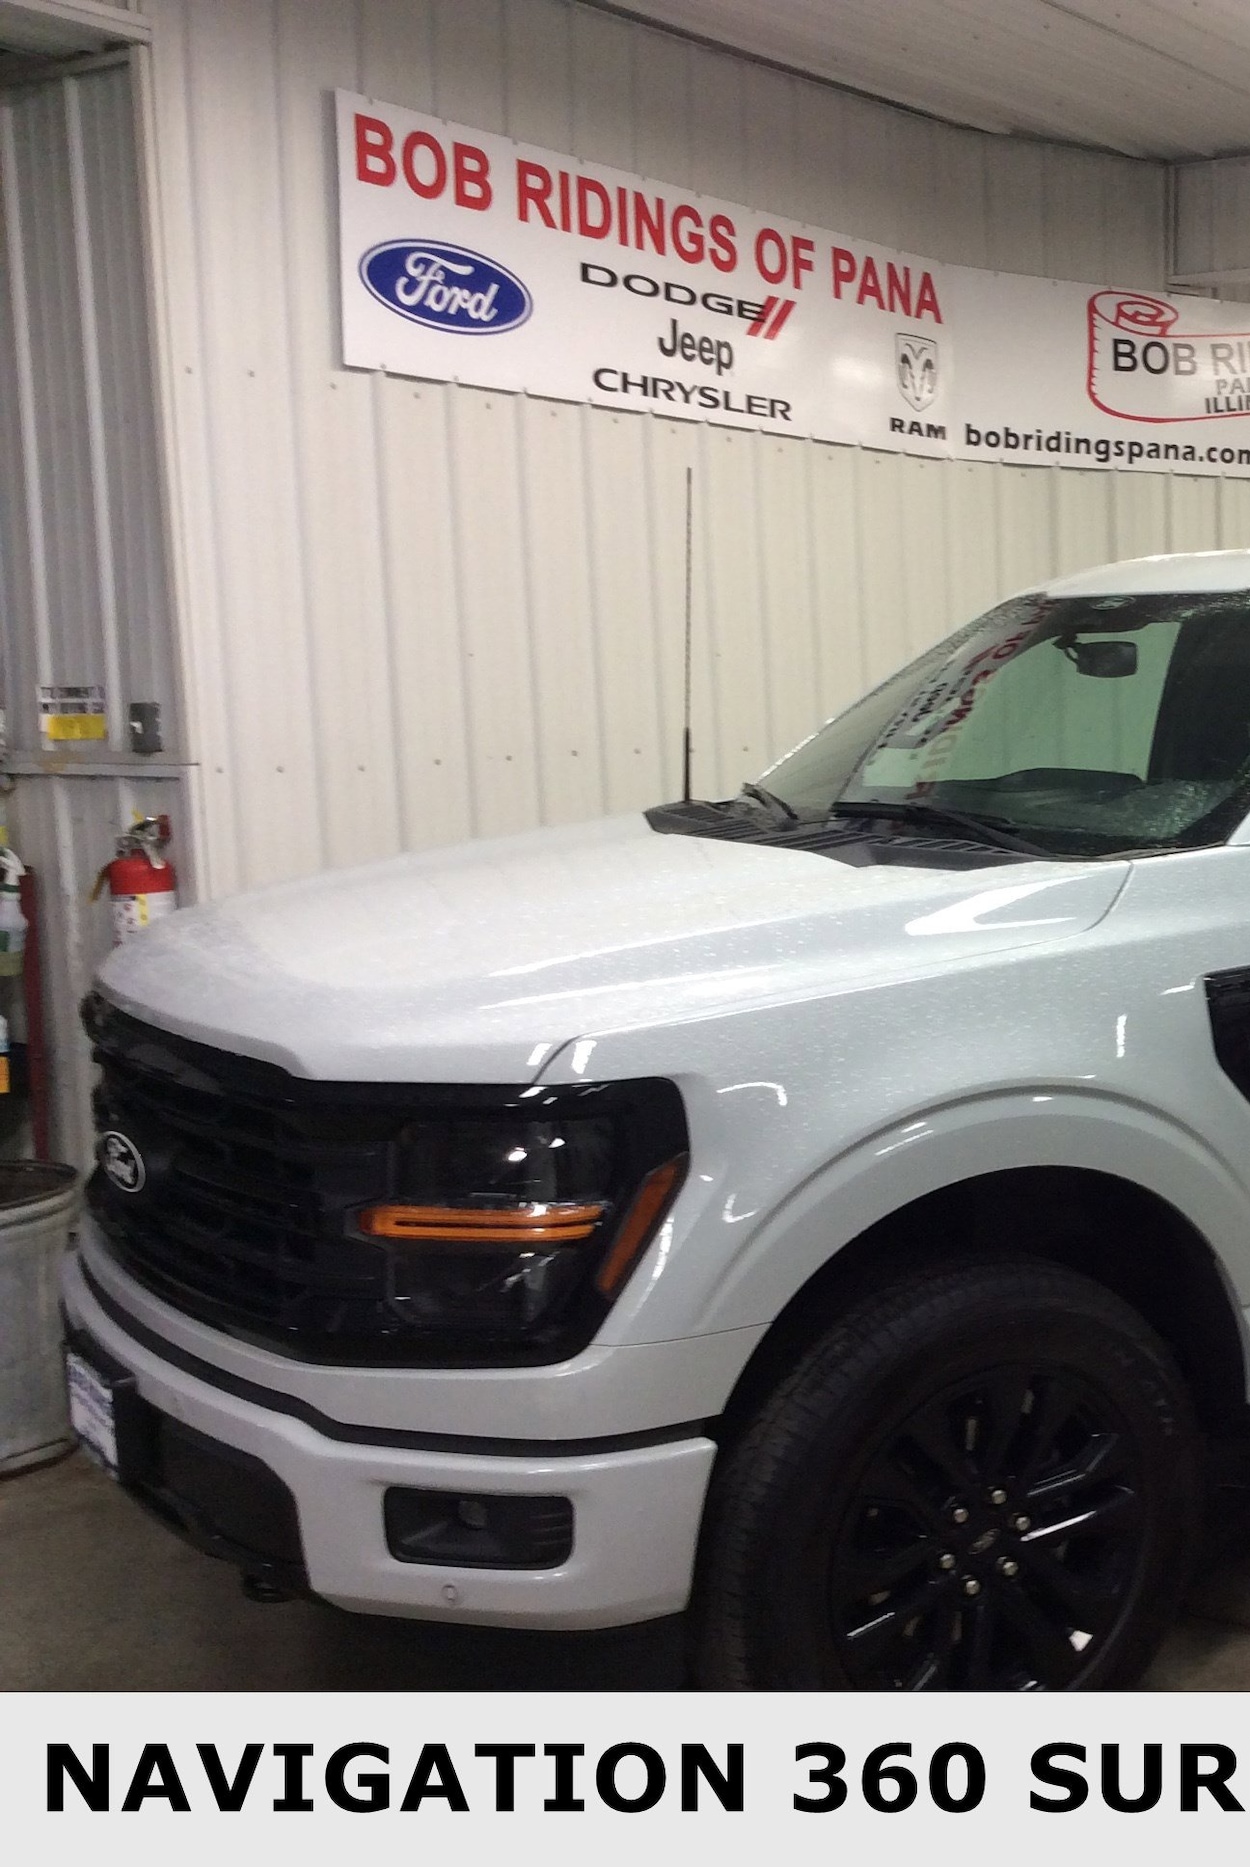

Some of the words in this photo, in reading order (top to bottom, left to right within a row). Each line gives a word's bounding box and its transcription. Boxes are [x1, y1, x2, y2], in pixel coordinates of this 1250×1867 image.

[354, 113, 493, 212] BOB
[516, 158, 738, 274] RIDINGS
[755, 227, 816, 291] OF
[830, 246, 944, 325] PANA
[395, 251, 500, 322] Ford
[580, 262, 767, 324] DODGE
[657, 317, 735, 377] Jeep
[1112, 337, 1198, 376] BOB
[591, 368, 793, 422] CHRYSLER
[889, 416, 947, 441] RAM
